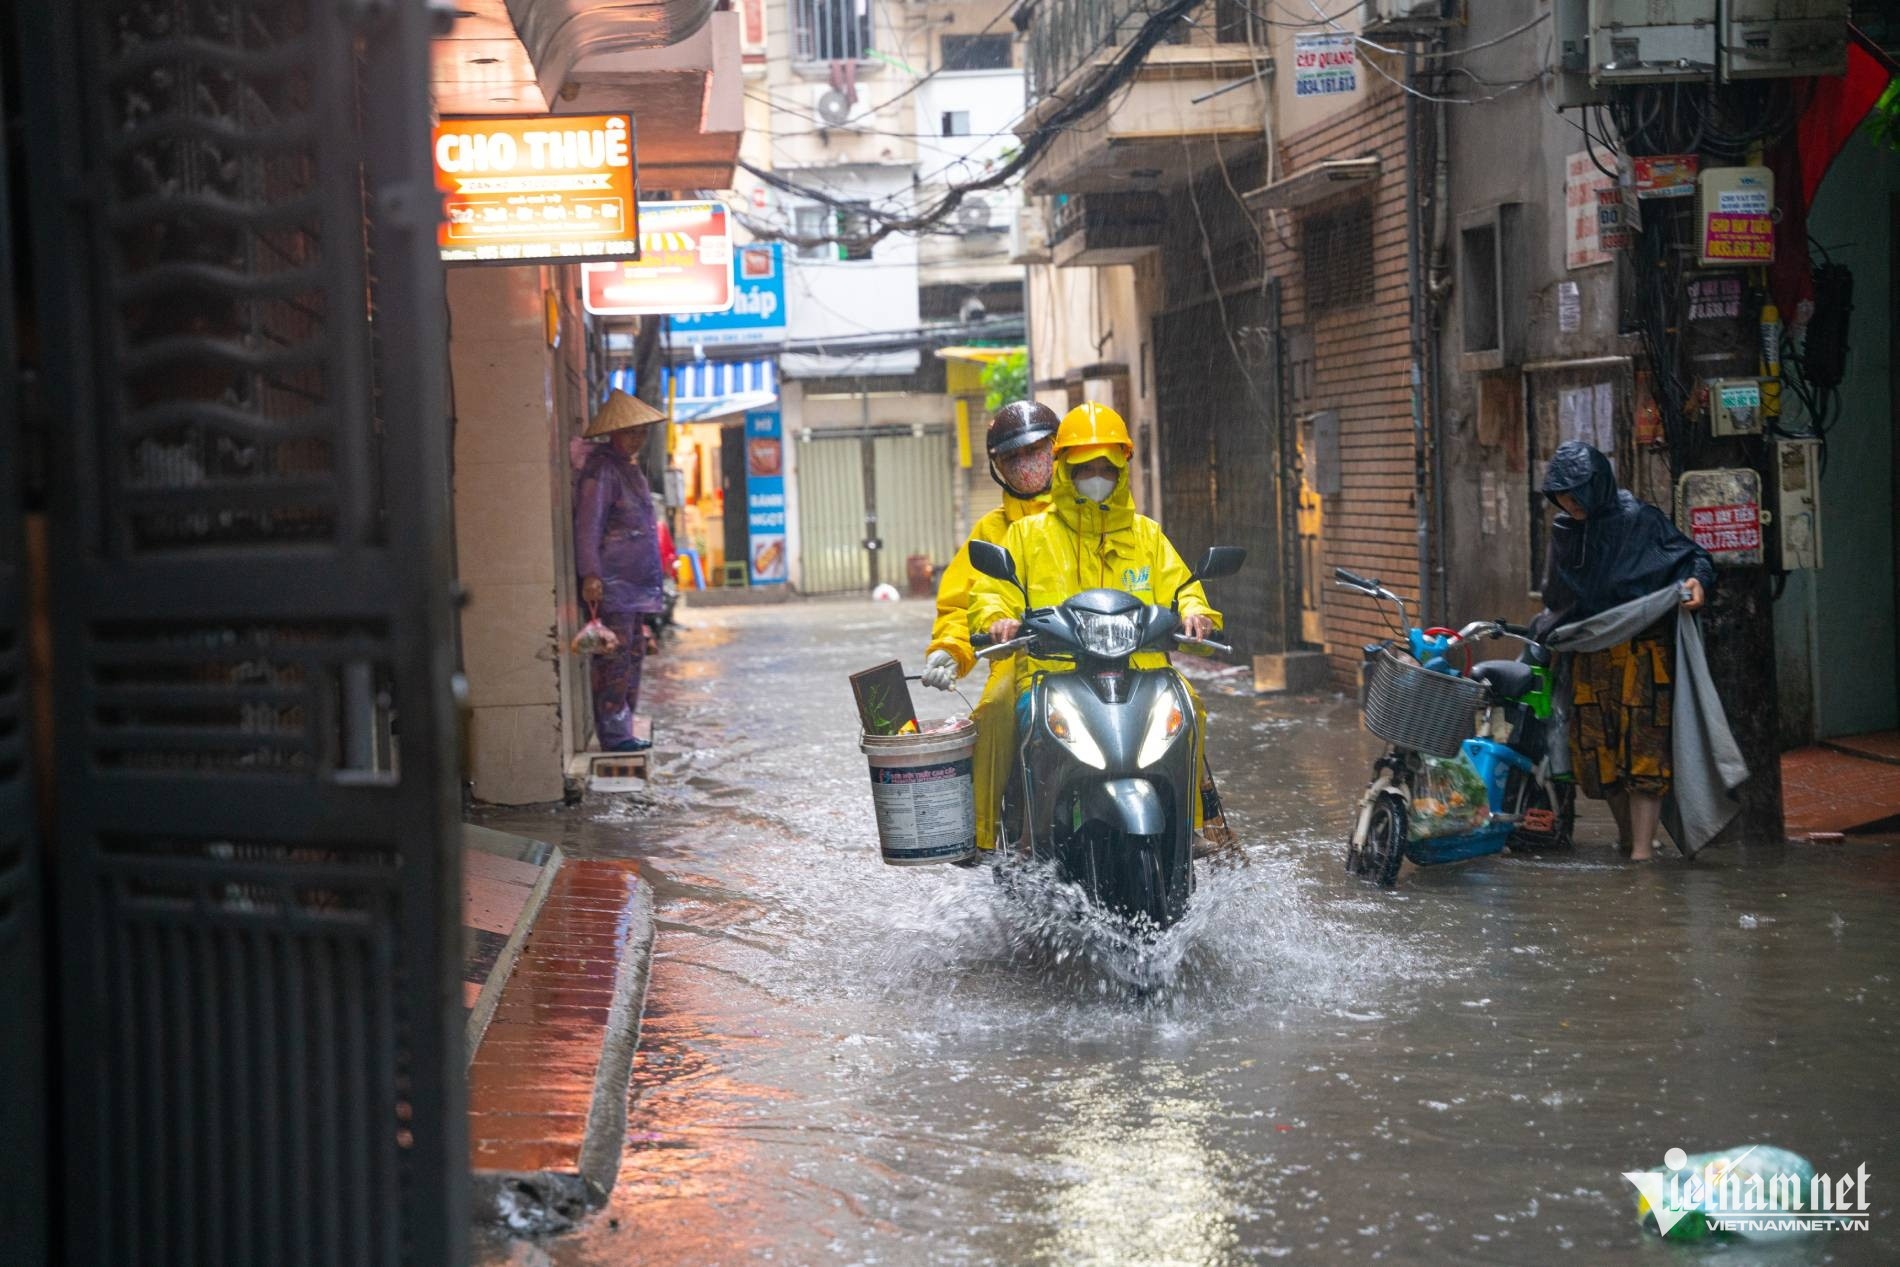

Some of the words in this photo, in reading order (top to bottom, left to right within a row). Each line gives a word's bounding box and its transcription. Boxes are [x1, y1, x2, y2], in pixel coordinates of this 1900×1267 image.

[1319, 51, 1354, 68] QUANG
[436, 132, 517, 173] CHO
[523, 117, 628, 170] THUÊ
[720, 285, 777, 319] háp
